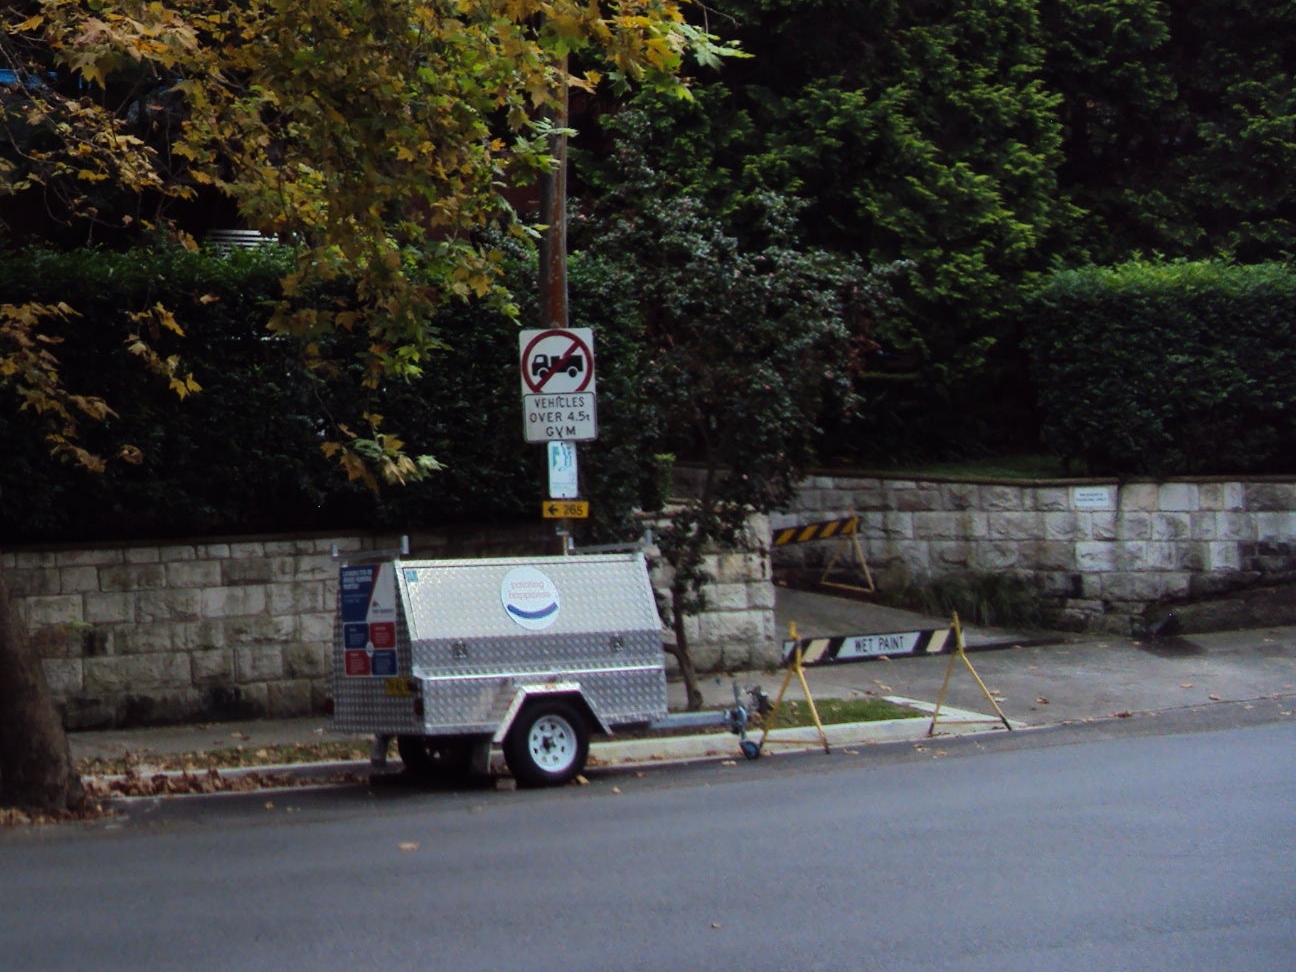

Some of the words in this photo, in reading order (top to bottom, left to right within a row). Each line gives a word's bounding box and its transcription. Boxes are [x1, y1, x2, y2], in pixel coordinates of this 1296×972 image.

[534, 395, 585, 409] VEHICLES
[529, 411, 563, 423] OVER
[566, 410, 591, 422] 4.5t
[545, 425, 576, 438] GVM
[854, 638, 873, 652] WET
[878, 635, 904, 651] PAINT
